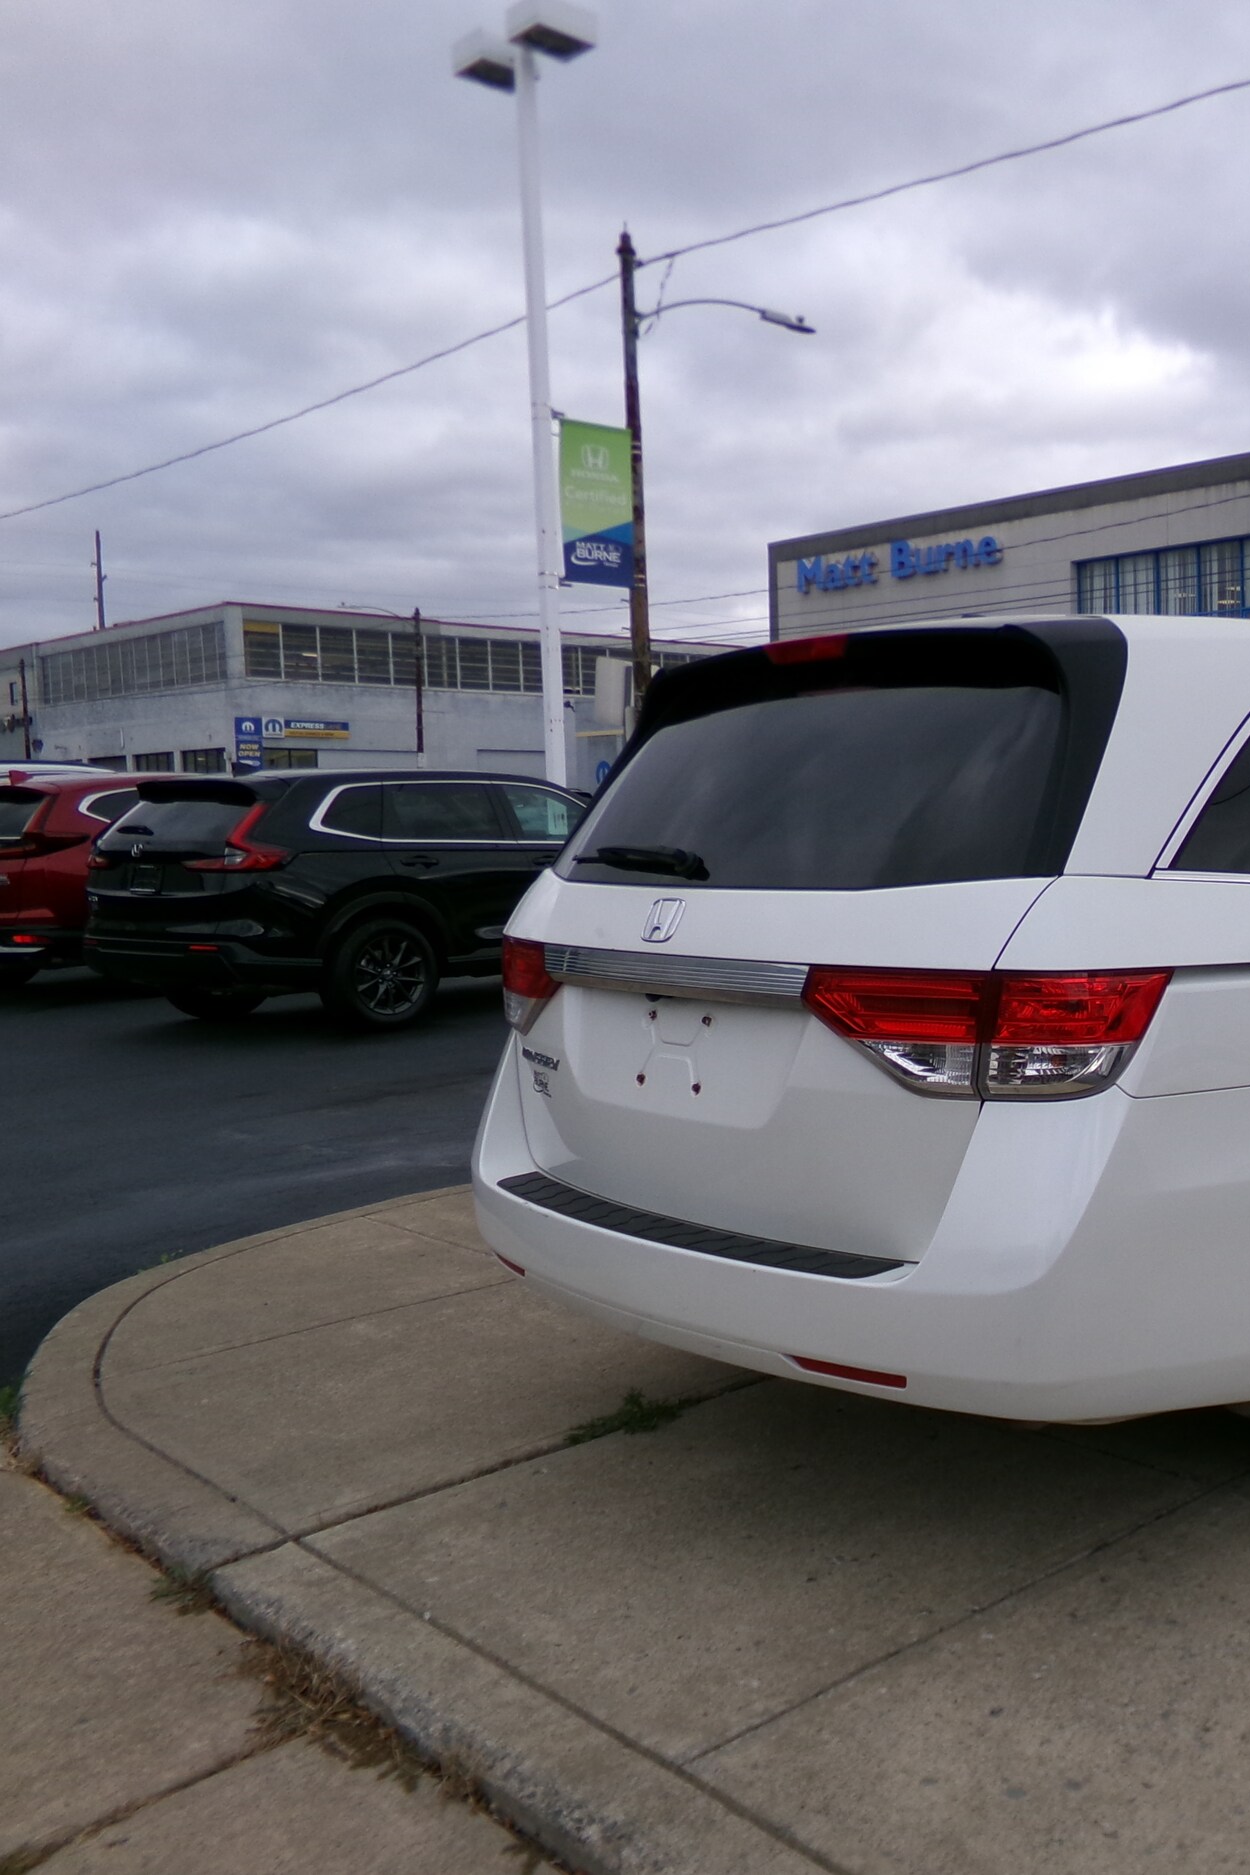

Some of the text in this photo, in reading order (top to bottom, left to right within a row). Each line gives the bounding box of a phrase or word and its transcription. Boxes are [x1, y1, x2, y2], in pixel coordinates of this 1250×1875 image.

[576, 541, 605, 552] MATT
[577, 548, 622, 563] BURNE
[797, 539, 1003, 593] Matt Burne
[290, 721, 325, 730] EXPRESS
[238, 750, 261, 758] OPEN
